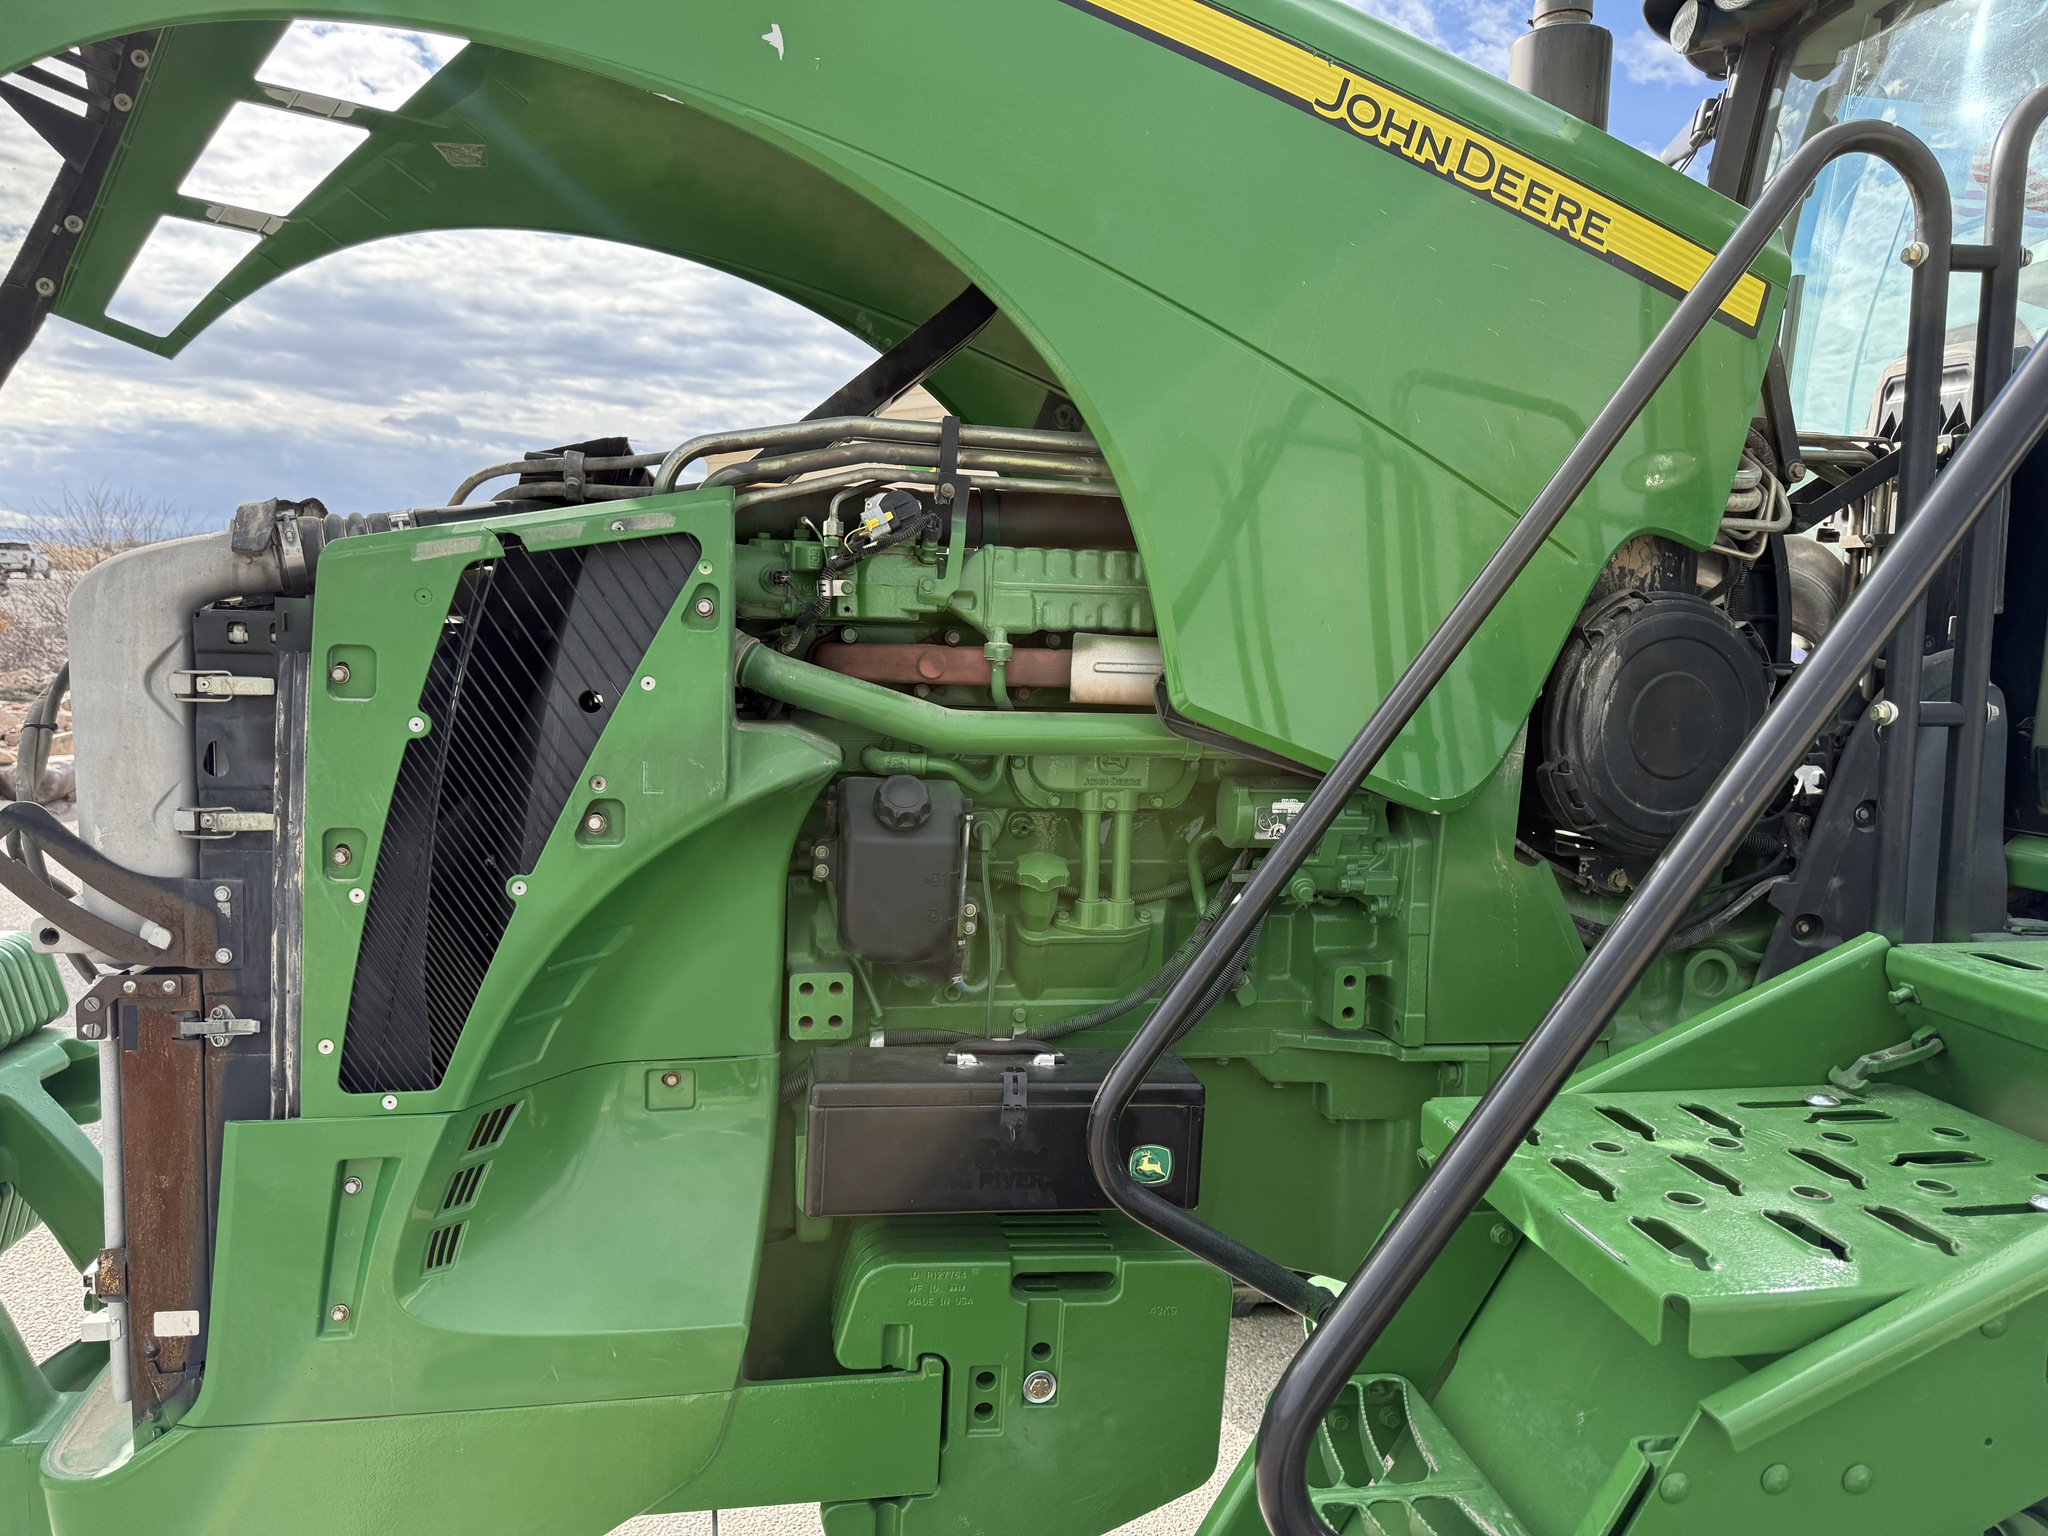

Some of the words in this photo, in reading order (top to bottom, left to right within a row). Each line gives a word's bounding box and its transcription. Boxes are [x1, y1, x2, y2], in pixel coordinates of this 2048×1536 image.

[1313, 78, 1453, 168] JOHN
[1456, 139, 1612, 247] DEERE
[1083, 777, 1109, 786] JOHN
[1110, 777, 1142, 786] DEERE
[907, 1297, 935, 1307] MADE
[939, 1297, 951, 1306] IN
[956, 1296, 975, 1306] USA
